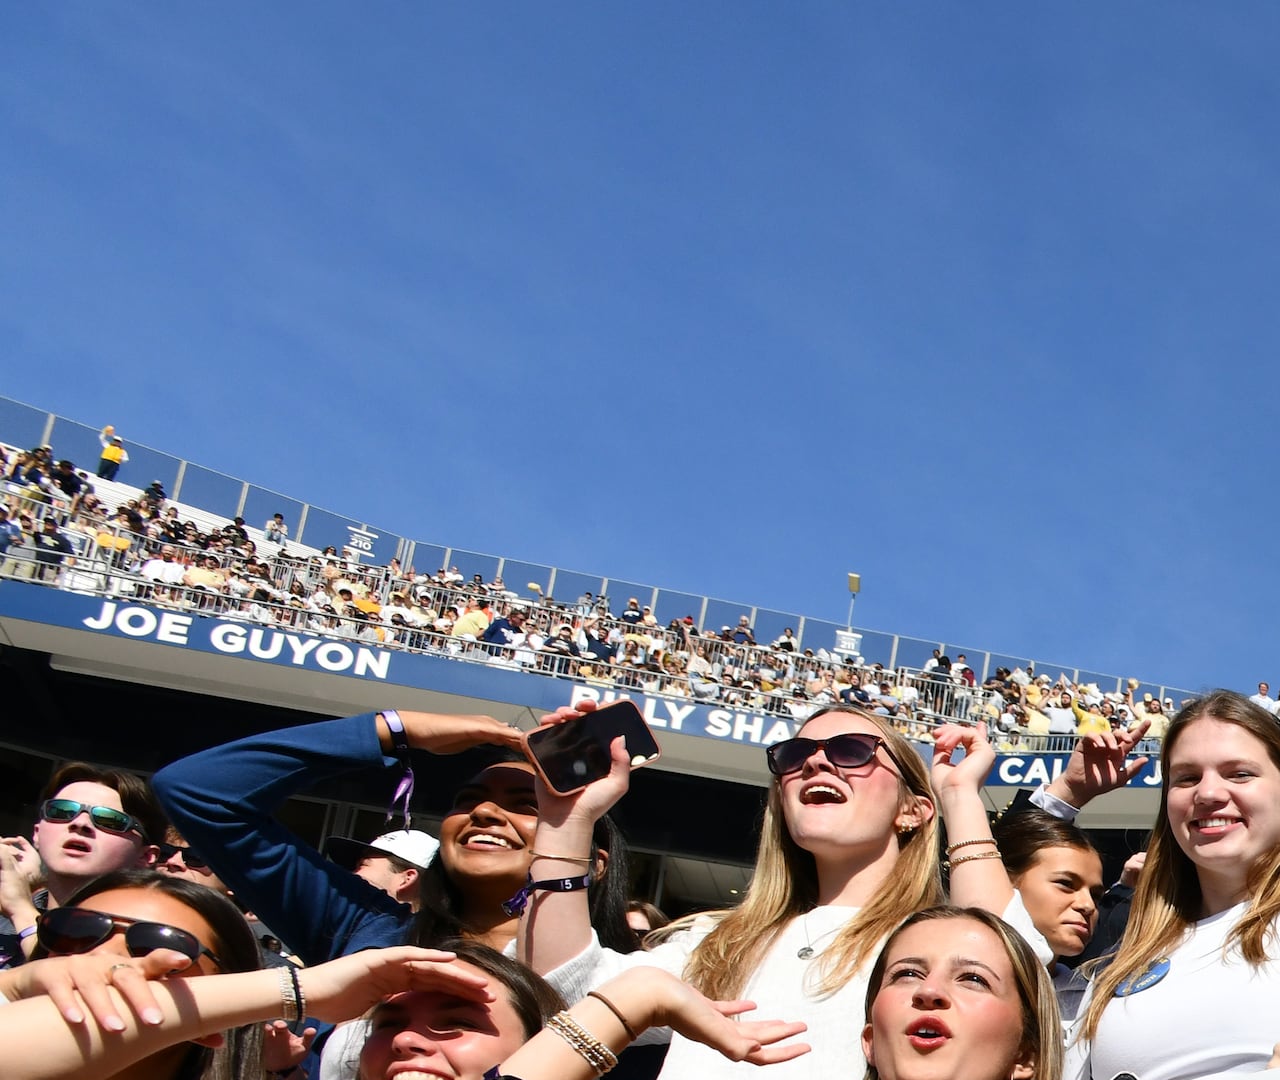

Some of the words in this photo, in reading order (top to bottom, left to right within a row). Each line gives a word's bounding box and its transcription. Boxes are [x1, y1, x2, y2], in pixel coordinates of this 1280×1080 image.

[349, 537, 372, 551] 210
[82, 601, 193, 645] JOE
[210, 623, 391, 679] GUYON
[570, 685, 696, 730] BLY
[705, 709, 801, 746] SHA
